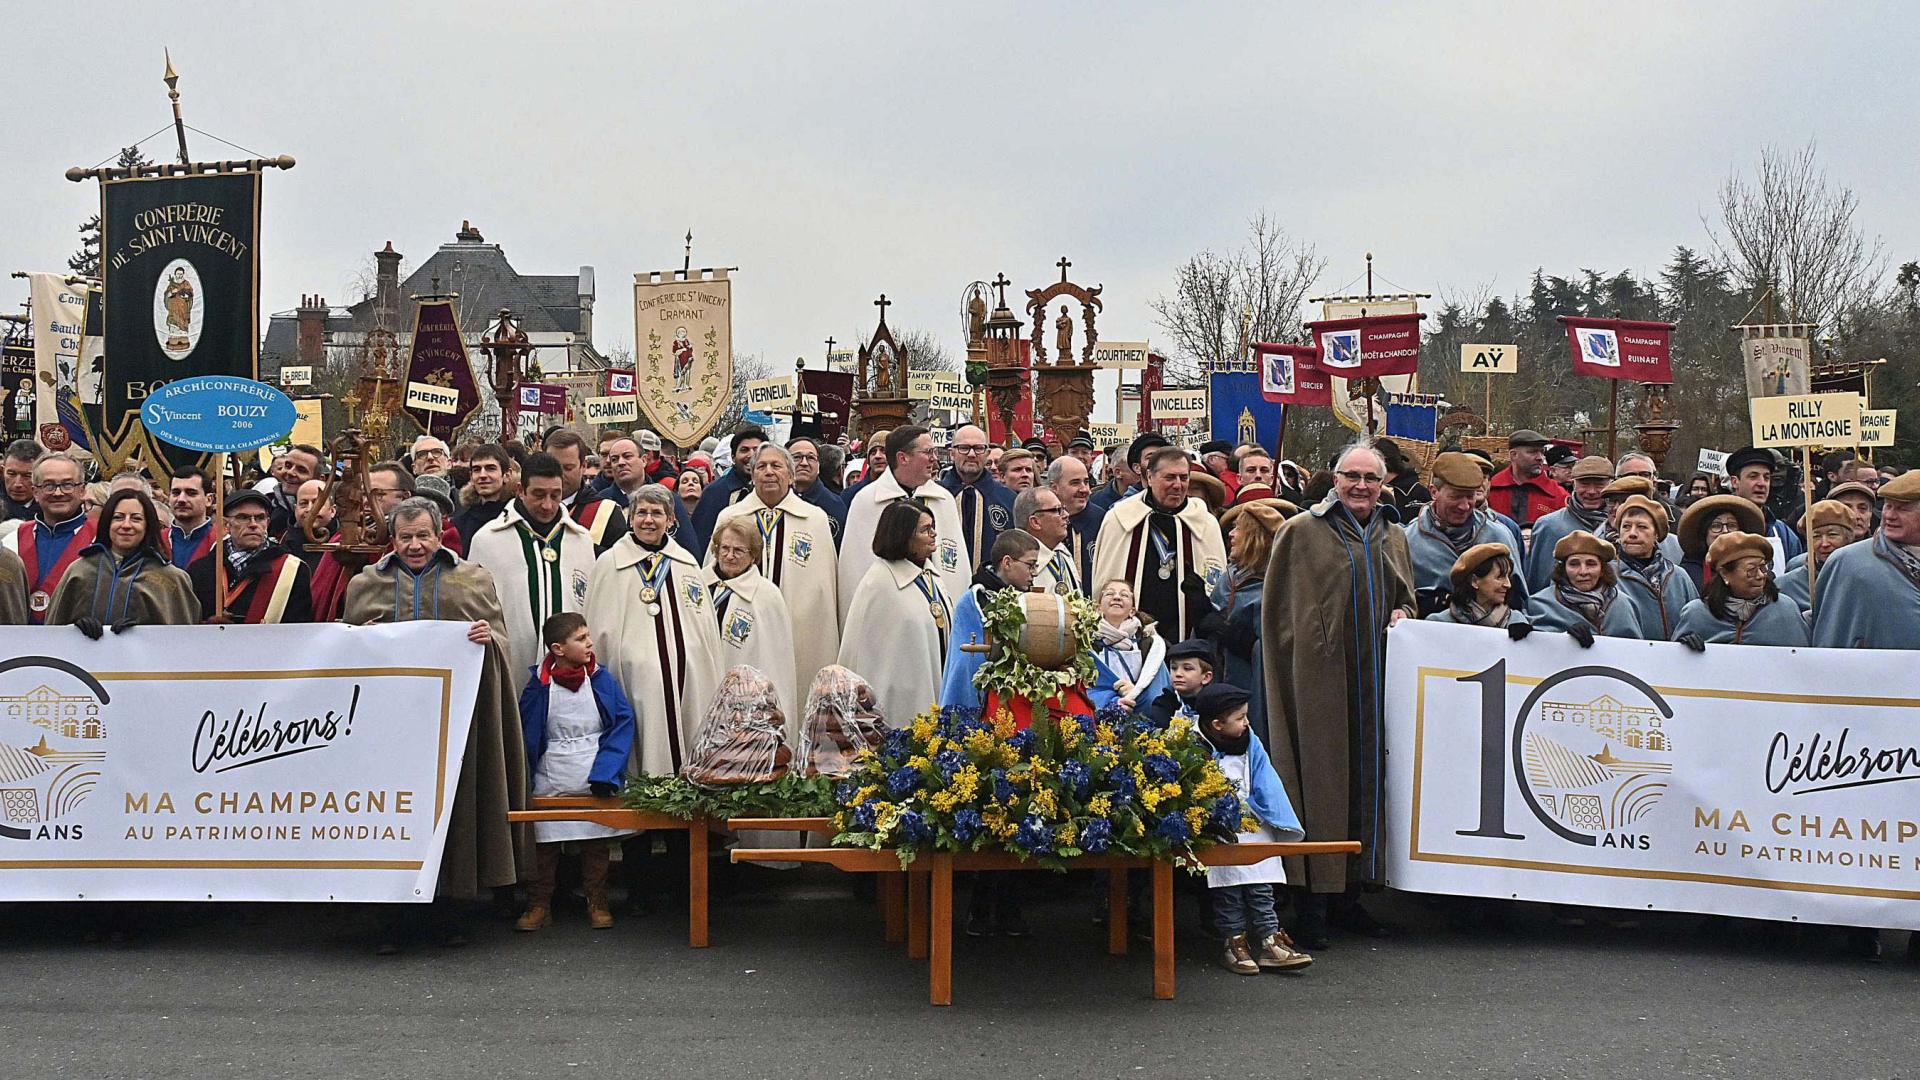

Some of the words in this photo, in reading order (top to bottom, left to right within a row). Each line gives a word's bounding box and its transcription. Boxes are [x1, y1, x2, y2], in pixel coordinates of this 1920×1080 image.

[111, 247, 130, 270] DE
[697, 291, 727, 307] VINCENT
[660, 308, 705, 321] CRAMANT
[1368, 331, 1410, 341] CHAMPAGNE
[1624, 335, 1662, 347] CHAMPAGNE
[1096, 349, 1146, 361] COURTHIEZY
[1472, 347, 1504, 369] AŸ
[1627, 354, 1659, 365] RUINART
[749, 383, 792, 404] VERNEUIL
[1300, 381, 1324, 390] MERCIER
[408, 389, 457, 407] PIERRY
[1152, 397, 1205, 411] VINCELLES
[164, 410, 202, 422] Vincent
[217, 404, 269, 418] BOUZY
[588, 400, 635, 418] CRAMANT
[1788, 400, 1823, 419] RILLY
[231, 420, 254, 430] 2006
[1091, 427, 1119, 437] PASSY
[1761, 424, 1778, 441] LA
[1781, 419, 1852, 440] MONTAGNE
[159, 429, 173, 440] DES
[174, 435, 213, 451] VIGNERONS
[214, 443, 225, 451] DE
[226, 442, 236, 451] LA
[237, 431, 281, 449] CHAMPAGNE
[1861, 430, 1880, 442] MAIN
[124, 792, 176, 814] MA
[194, 790, 414, 815] CHAMPAGNE
[36, 824, 84, 841] ANS
[124, 825, 155, 841] AU
[166, 825, 302, 841] PATRIMOINE
[311, 825, 411, 841] MONDIAL
[1695, 806, 1752, 832] MA
[1772, 812, 1919, 844] CHAMP
[1602, 832, 1651, 851] ANS
[1695, 841, 1728, 856] AU
[1741, 844, 1901, 871] PATRIMOINE
